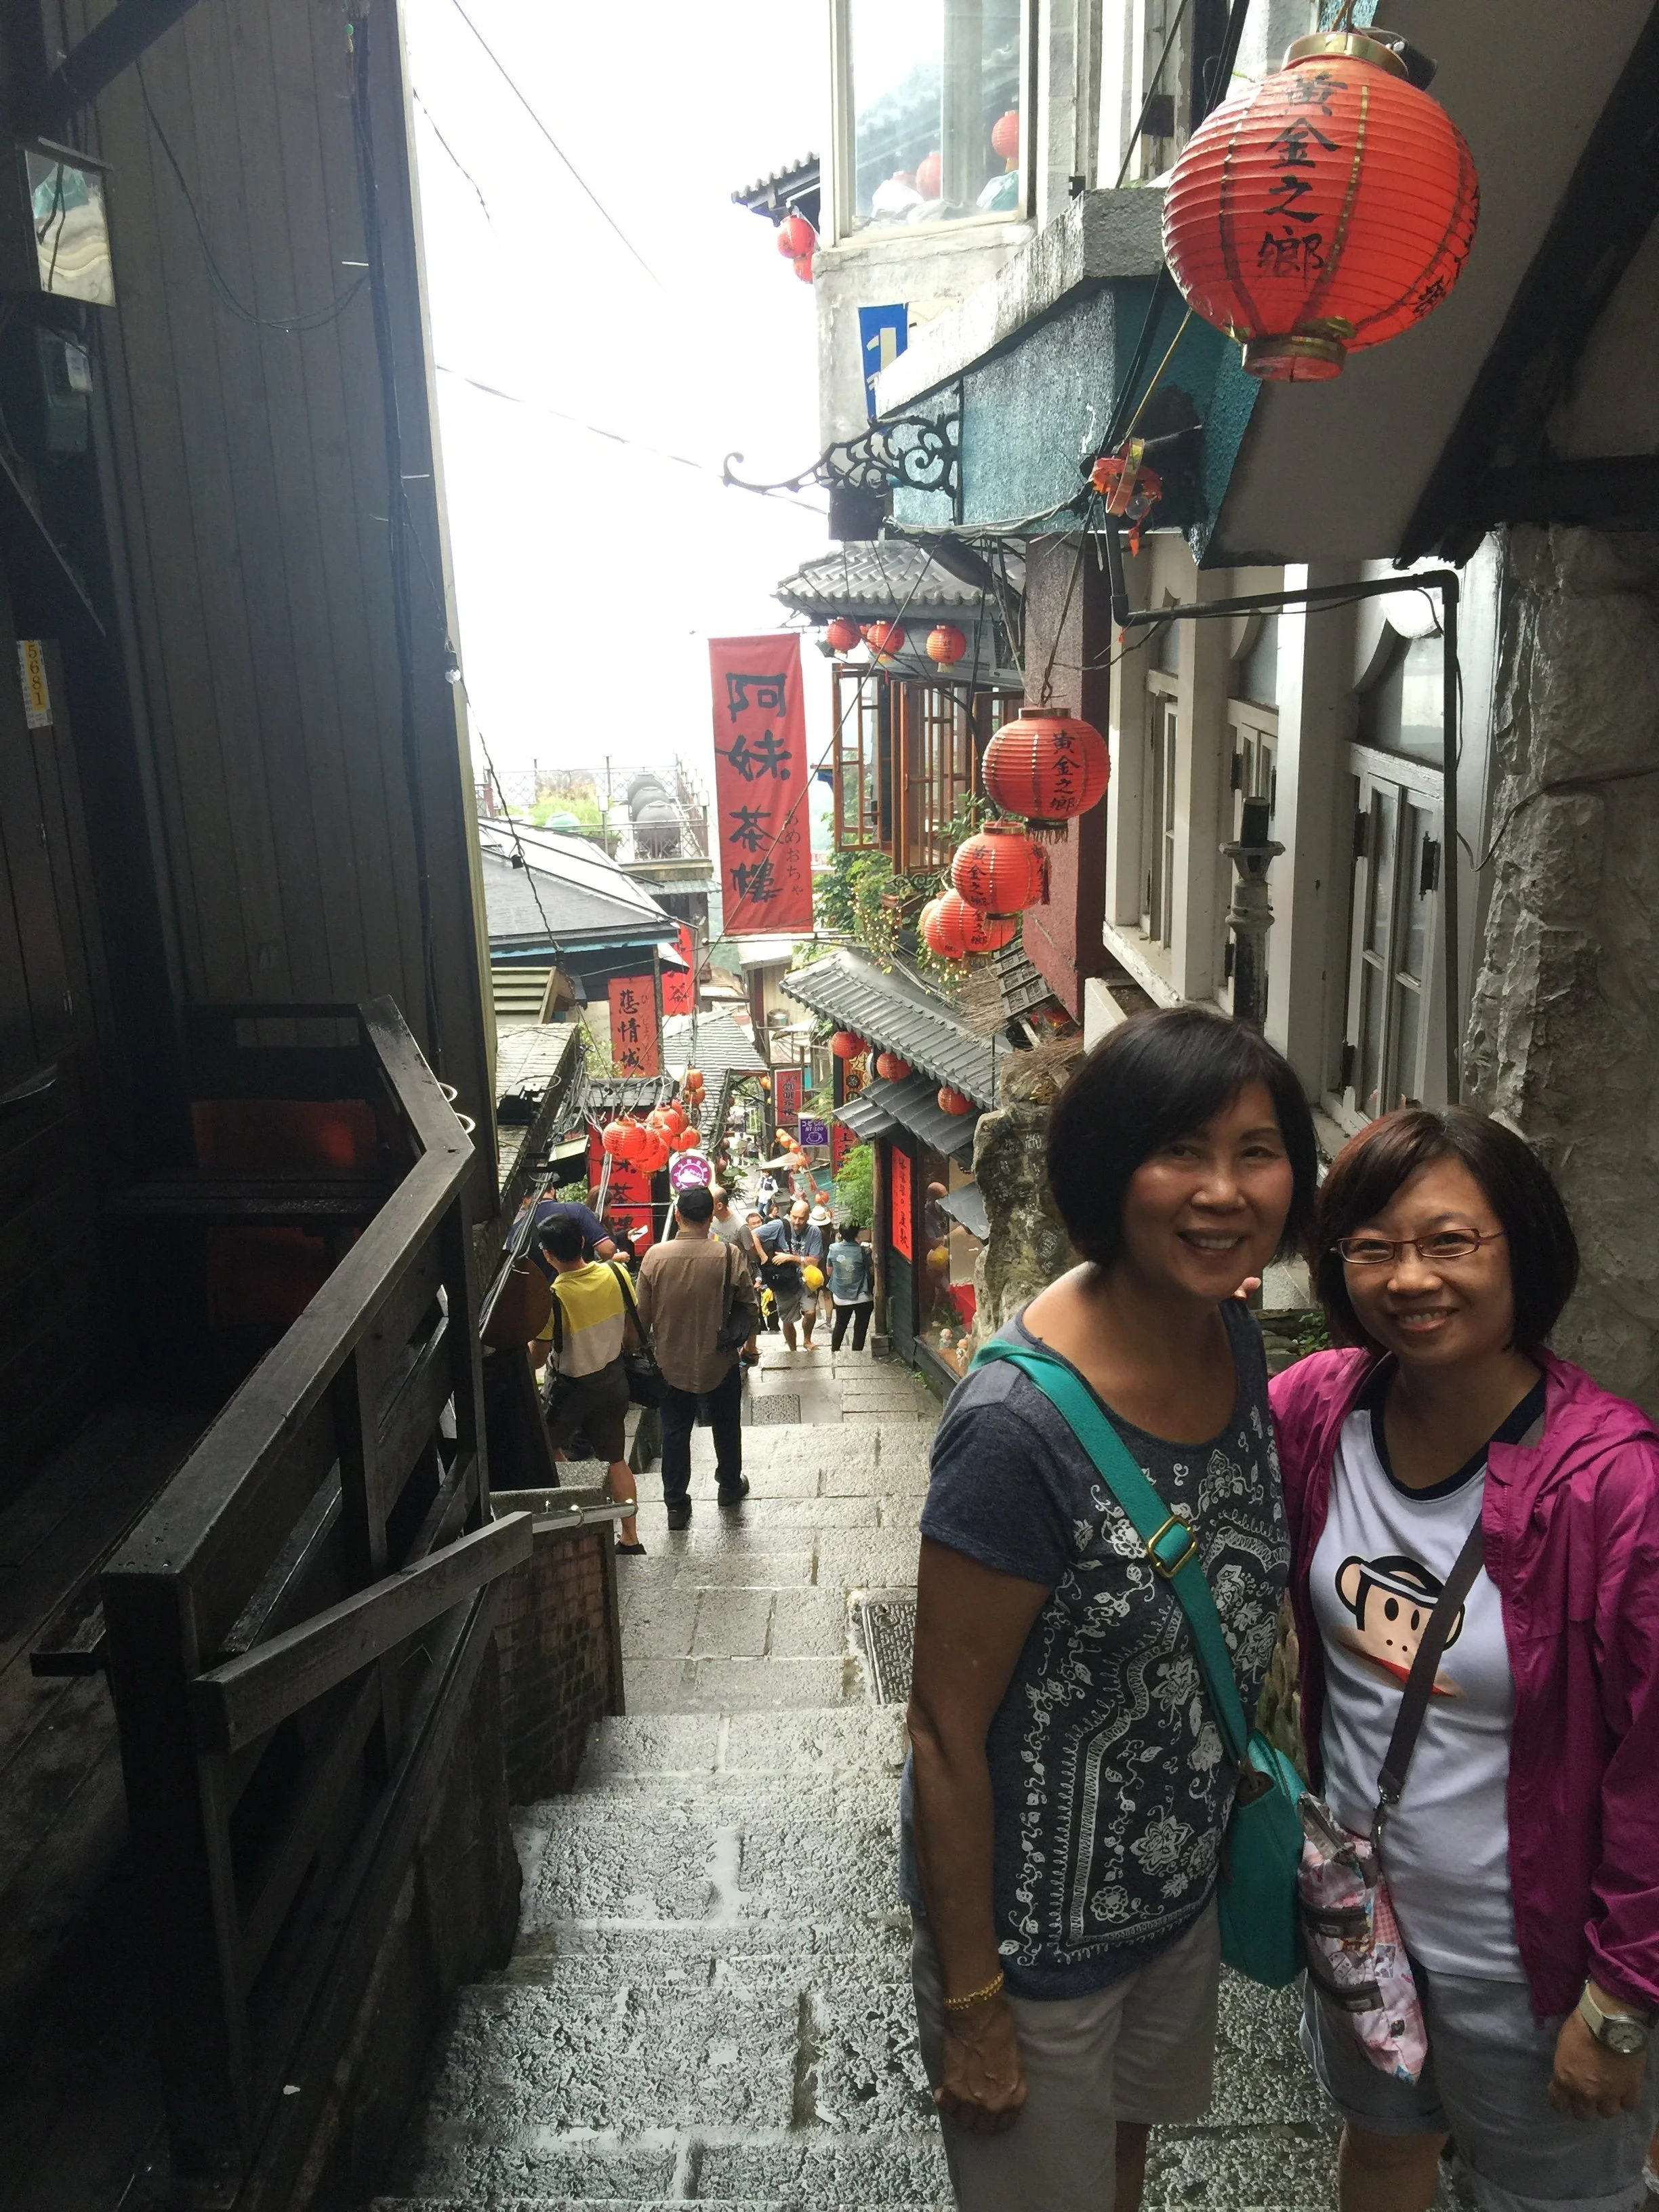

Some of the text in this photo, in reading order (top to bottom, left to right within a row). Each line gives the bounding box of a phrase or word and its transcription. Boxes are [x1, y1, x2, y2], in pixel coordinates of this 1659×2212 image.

[27, 641, 44, 705] 5681
[716, 673, 792, 903] 阿妹茶樓
